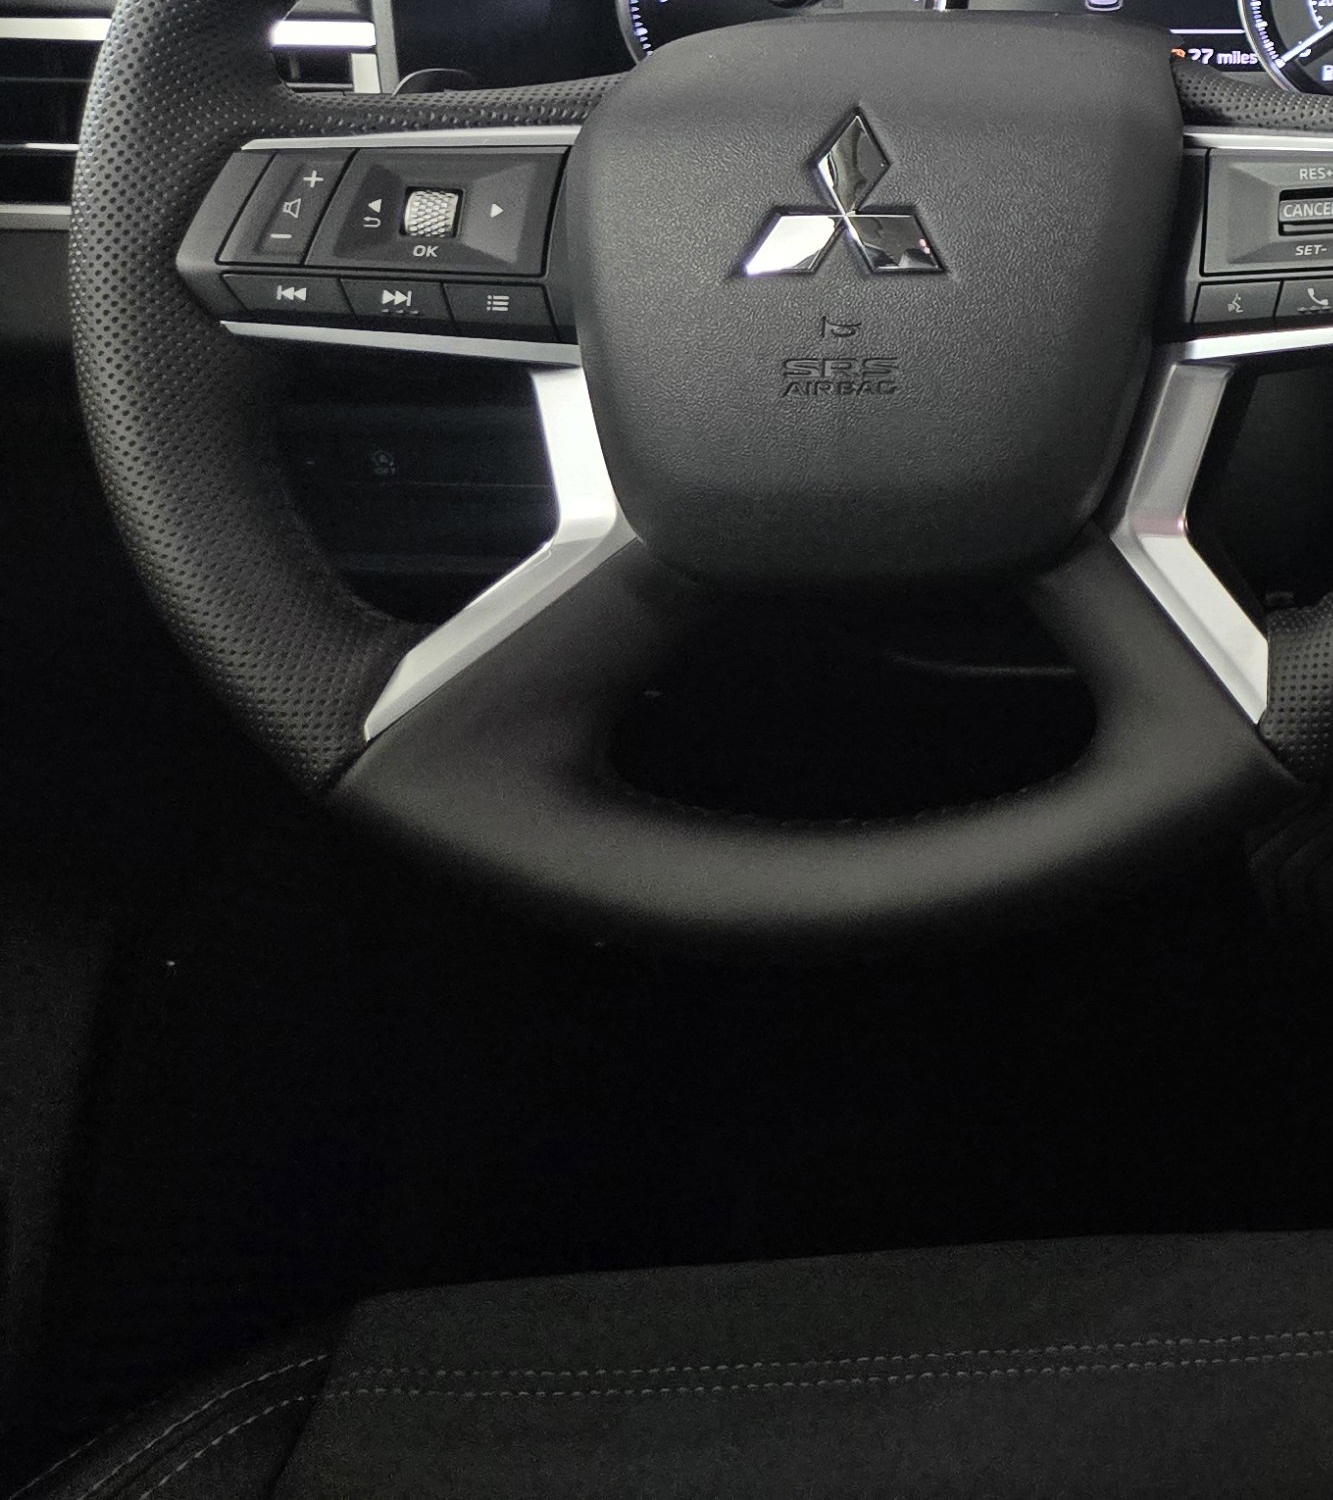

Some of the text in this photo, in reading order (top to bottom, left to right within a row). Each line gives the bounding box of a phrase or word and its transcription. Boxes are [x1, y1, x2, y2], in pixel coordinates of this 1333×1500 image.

[1216, 50, 1259, 65] miles
[1300, 167, 1333, 181] RES+
[412, 244, 438, 259] OK
[782, 357, 900, 378] SRS
[780, 380, 899, 398] AIRBAG
